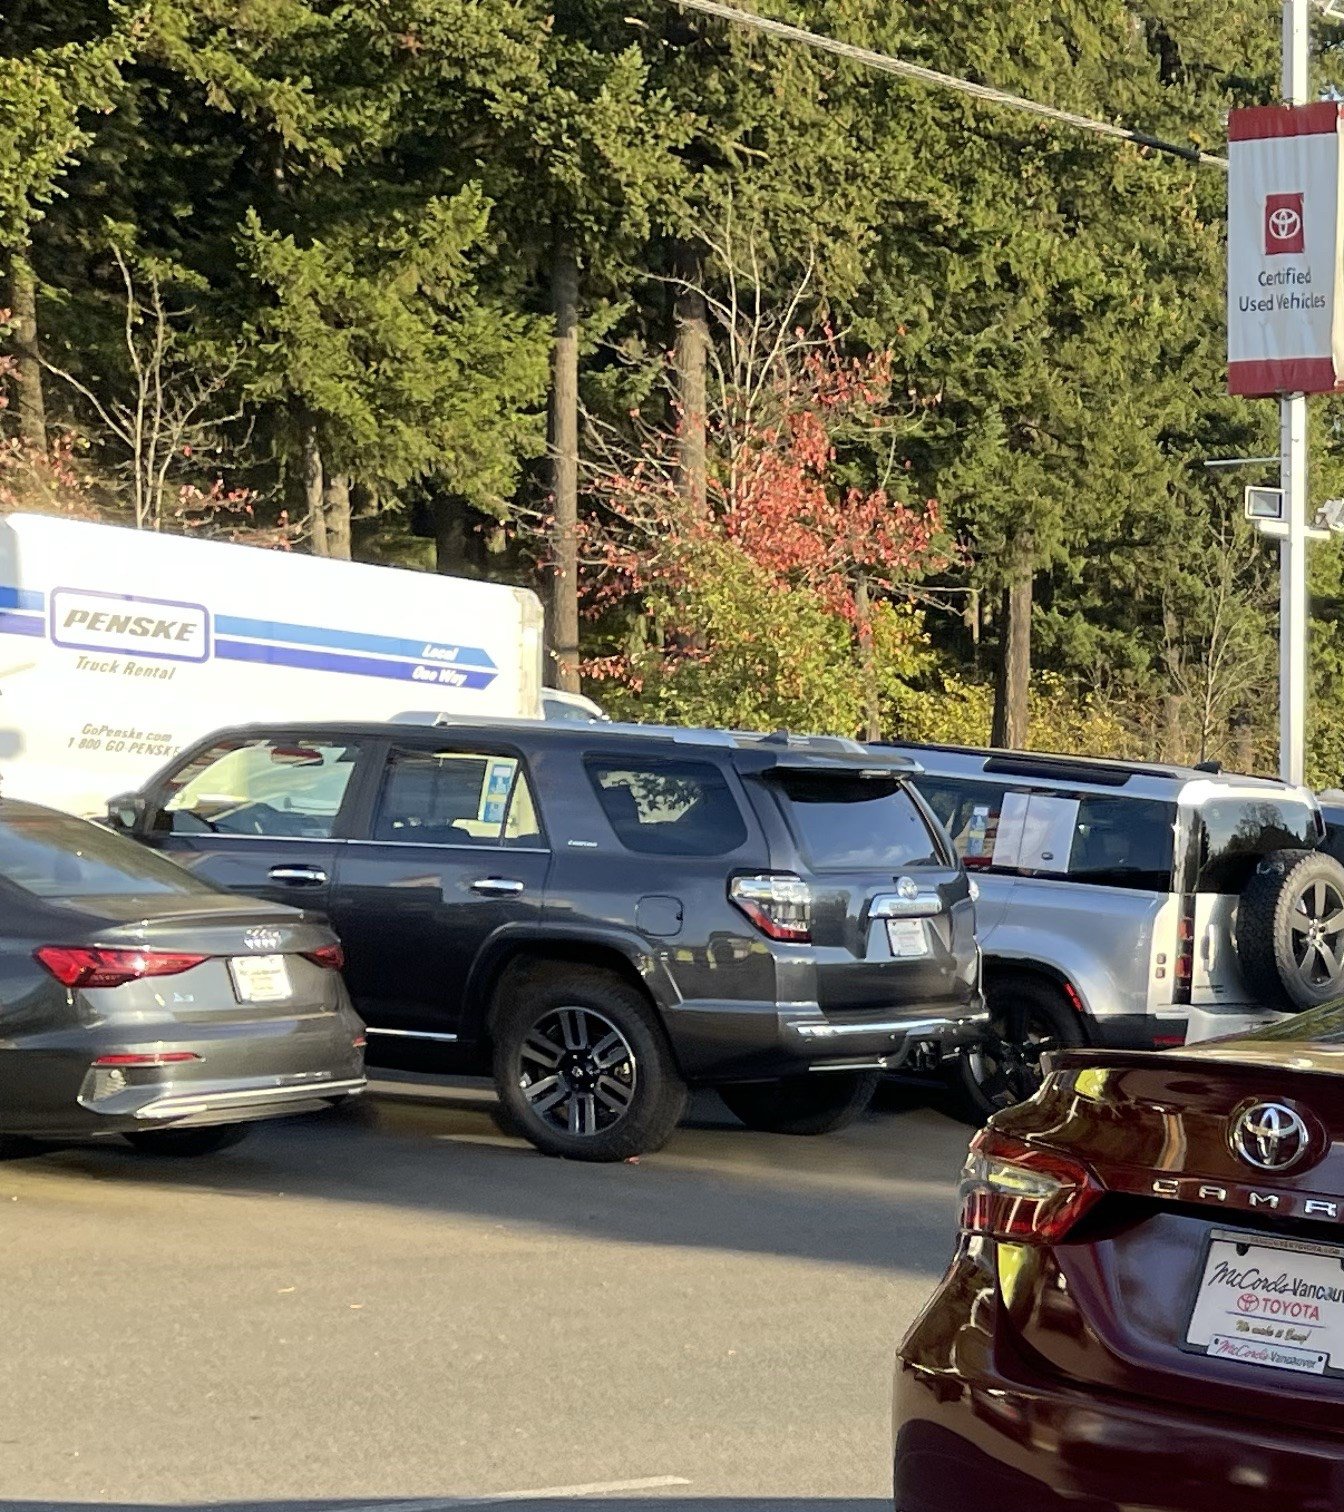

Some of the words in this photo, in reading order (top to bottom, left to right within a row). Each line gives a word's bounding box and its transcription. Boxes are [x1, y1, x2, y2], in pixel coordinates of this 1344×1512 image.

[1257, 266, 1312, 287] Certified
[1238, 293, 1274, 312] Used
[1275, 291, 1326, 311] Vehicles
[63, 609, 198, 641] PENSKE
[421, 643, 460, 661] Local
[75, 655, 120, 674] Truck
[122, 661, 177, 681] Rental
[411, 665, 438, 682] One
[438, 668, 469, 688] Way
[81, 723, 173, 743] GoPenskecom
[1262, 1299, 1320, 1321] TOYOTA
